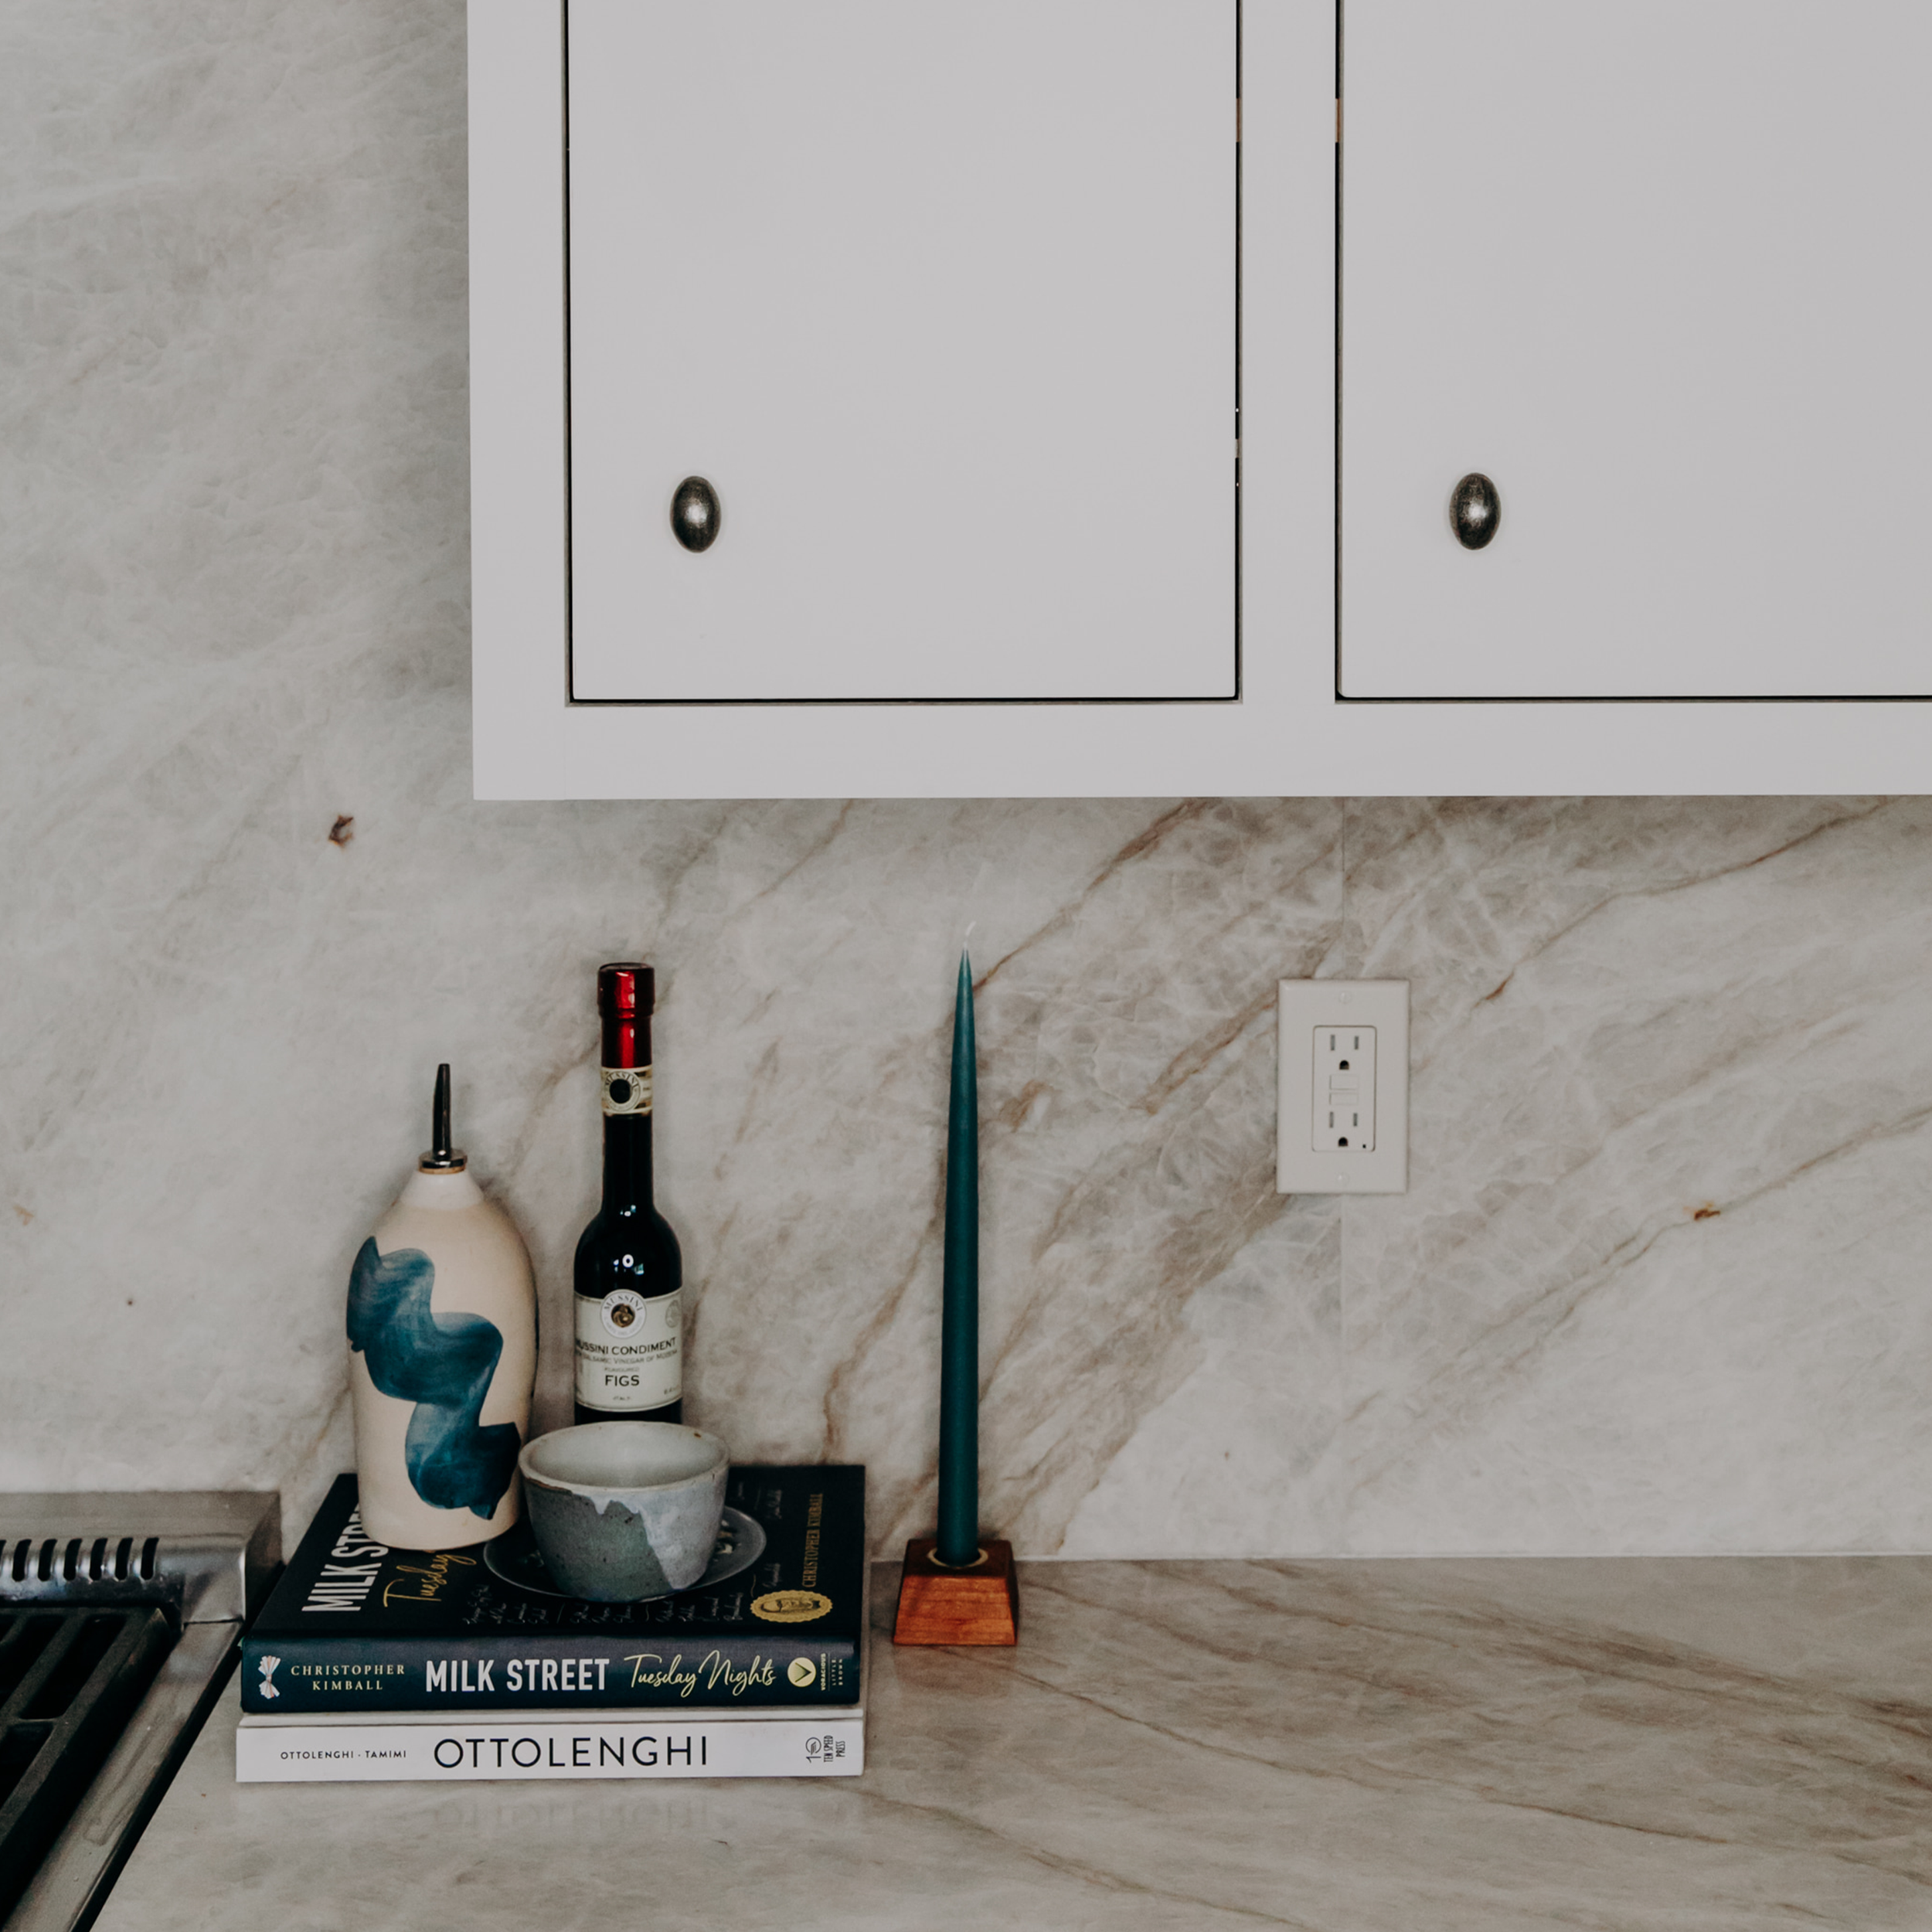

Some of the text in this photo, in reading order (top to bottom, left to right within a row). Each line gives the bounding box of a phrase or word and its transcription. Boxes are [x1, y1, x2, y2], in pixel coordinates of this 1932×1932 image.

[604, 1294, 643, 1311] MUSSINI
[611, 1337, 676, 1355] CONDIMENT
[605, 1374, 640, 1387] FIGS
[801, 1529, 821, 1588] CHRISTOPHER
[301, 1563, 382, 1611] MILK
[383, 1554, 477, 1607] Tuesday
[291, 1664, 405, 1675] CHRISTOPHER
[426, 1658, 610, 1692] MILK STREET
[624, 1650, 777, 1699] Tuesday Nights
[312, 1680, 383, 1691] KIMBALL
[280, 1750, 407, 1760] OTTOLENGHI TAMIMI
[434, 1736, 707, 1769] OTTOLENGHI
[823, 1735, 834, 1763] TEN SPEED
